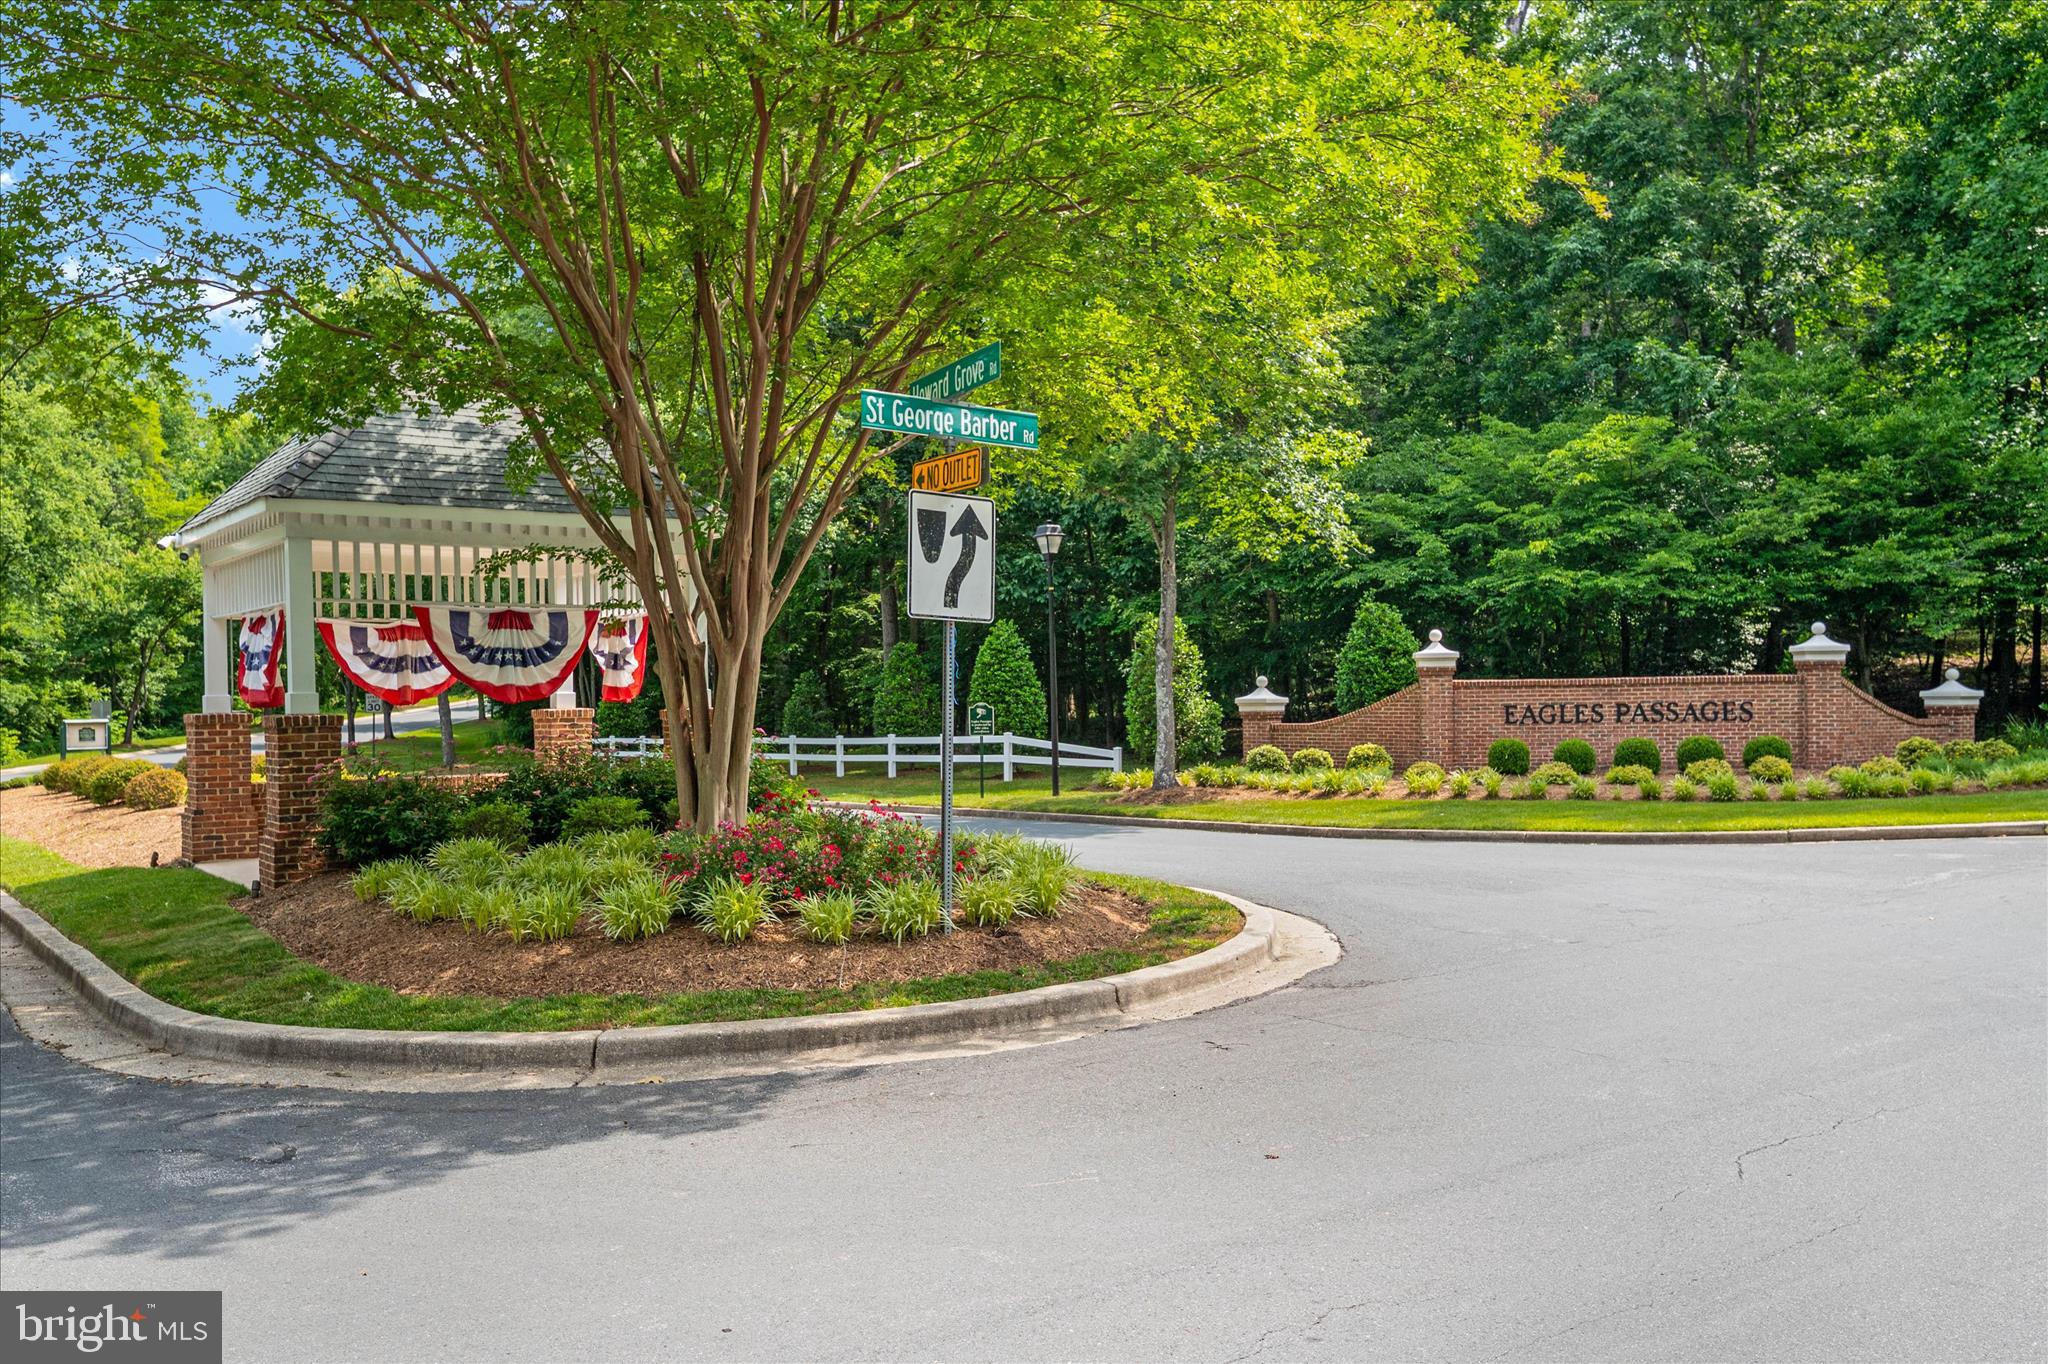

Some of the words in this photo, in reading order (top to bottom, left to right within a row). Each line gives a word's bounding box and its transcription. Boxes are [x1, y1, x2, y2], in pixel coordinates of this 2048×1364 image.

[954, 359, 985, 392] Grove
[989, 361, 998, 376] Rd
[866, 395, 885, 425] St
[892, 399, 954, 435] George
[960, 408, 1018, 442] Barber
[1023, 429, 1035, 445] Rd
[926, 463, 940, 489] NO
[942, 454, 978, 487] OUTLET
[367, 703, 381, 711] 30
[1503, 702, 1604, 726] EAGLES
[1614, 700, 1755, 724] PASSAGES
